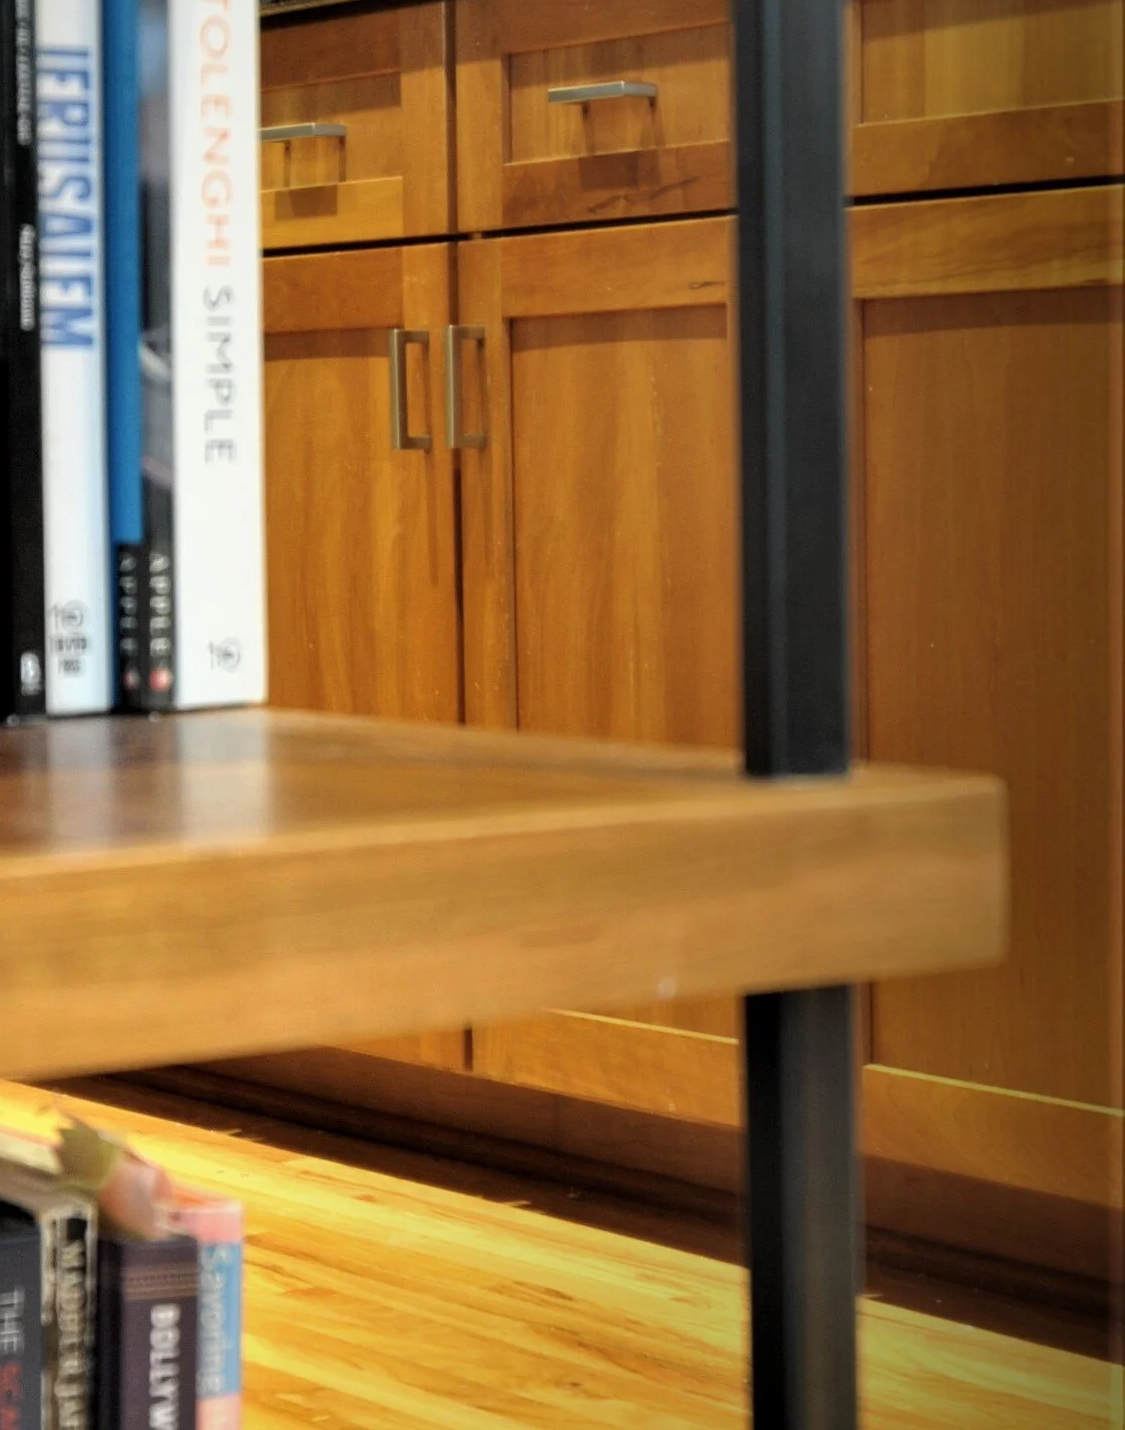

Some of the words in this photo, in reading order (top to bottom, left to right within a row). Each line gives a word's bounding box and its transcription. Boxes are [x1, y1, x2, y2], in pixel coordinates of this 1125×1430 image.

[37, 44, 95, 352] JERUSALEM
[201, 284, 237, 465] SIMPLE
[147, 551, 172, 657] APPLE
[196, 1244, 233, 1395] Savoring
